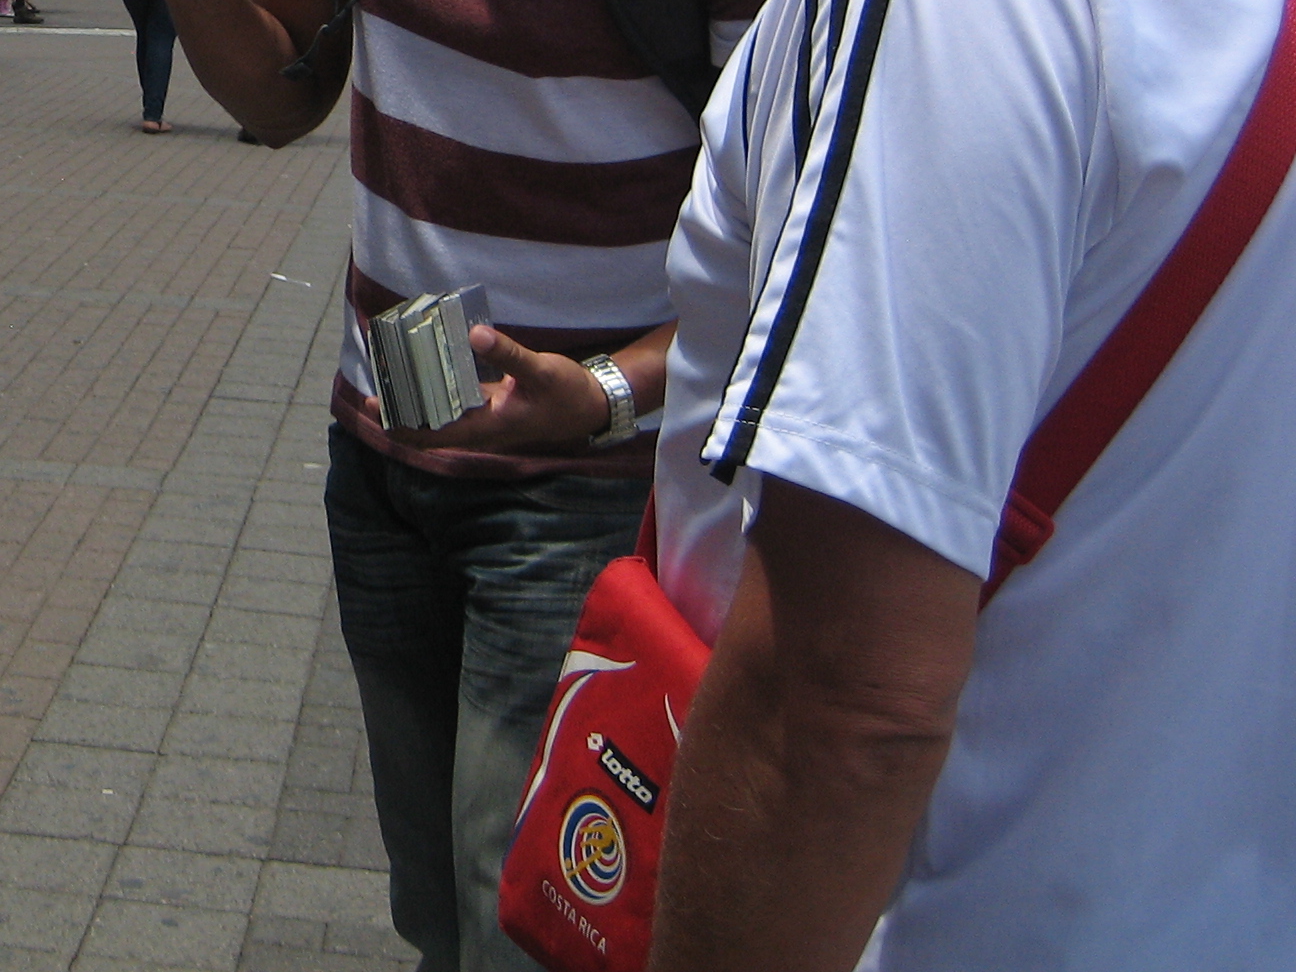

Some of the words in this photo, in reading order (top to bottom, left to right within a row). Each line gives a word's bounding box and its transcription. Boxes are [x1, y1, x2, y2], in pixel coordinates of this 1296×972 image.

[601, 748, 653, 804] lotto
[542, 879, 577, 925] COSTA
[578, 916, 607, 955] RICA
